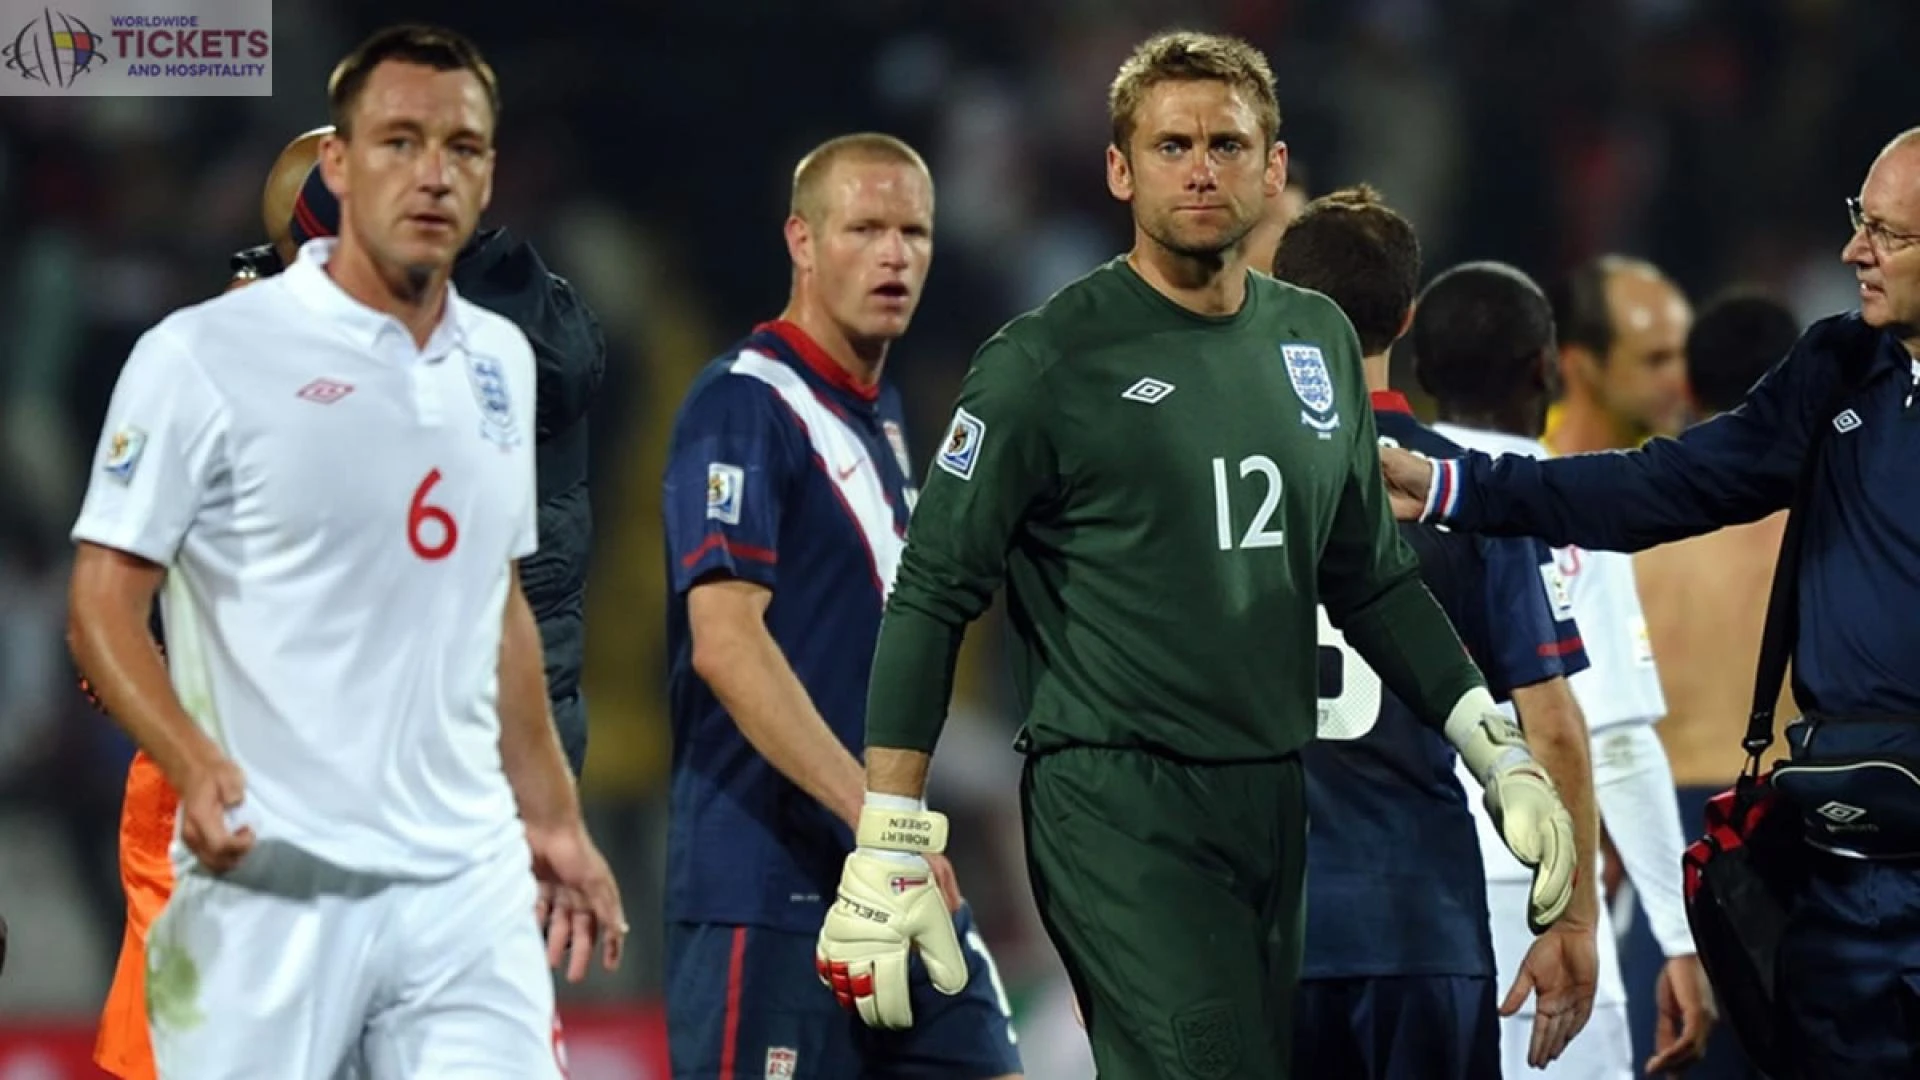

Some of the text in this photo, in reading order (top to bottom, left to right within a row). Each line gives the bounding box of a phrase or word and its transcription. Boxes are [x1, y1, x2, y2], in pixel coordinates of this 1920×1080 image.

[407, 467, 459, 561] 6
[1212, 455, 1284, 551] 12
[880, 831, 930, 846] ROBERT
[889, 818, 932, 832] GREEN
